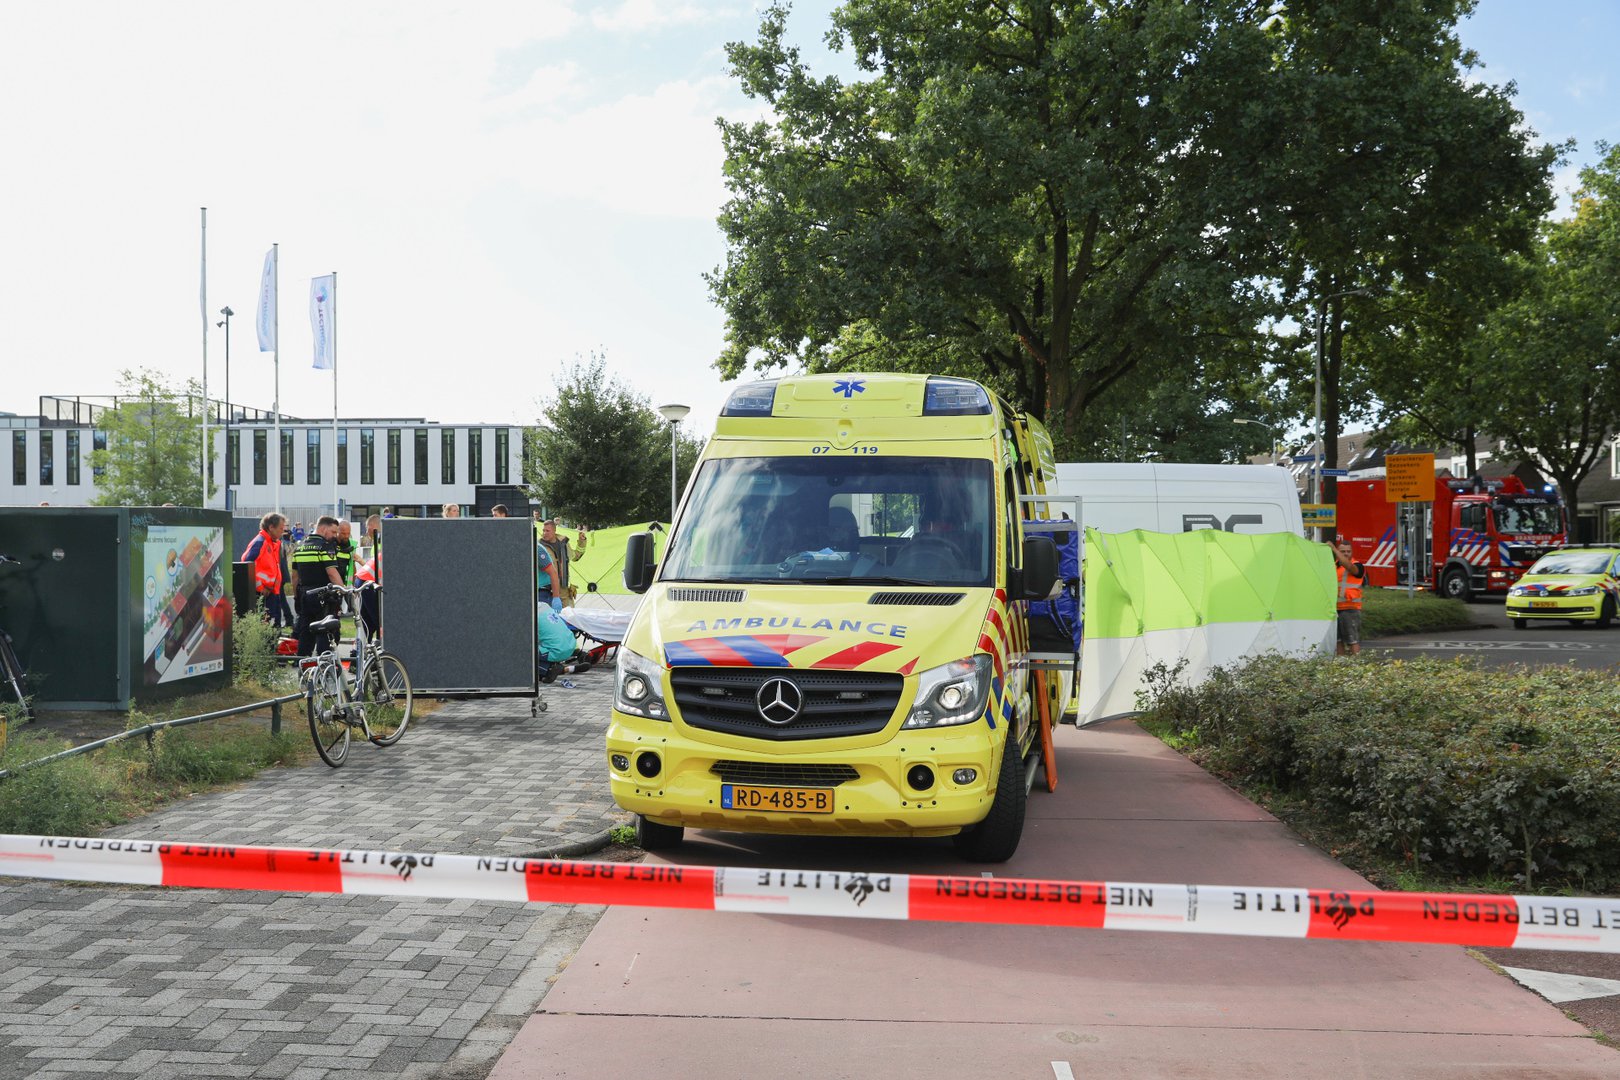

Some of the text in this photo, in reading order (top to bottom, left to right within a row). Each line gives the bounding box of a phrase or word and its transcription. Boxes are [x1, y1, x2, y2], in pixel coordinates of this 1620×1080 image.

[812, 446, 878, 454] 07 119
[686, 617, 908, 638] AMBULANCE
[737, 789, 827, 809] RD-485-B
[477, 859, 614, 880] BETREDEN
[625, 866, 682, 884] NIET
[936, 879, 1082, 903] BETREDEN
[1093, 887, 1153, 907] NIET
[1423, 900, 1580, 927] BETREDEN
